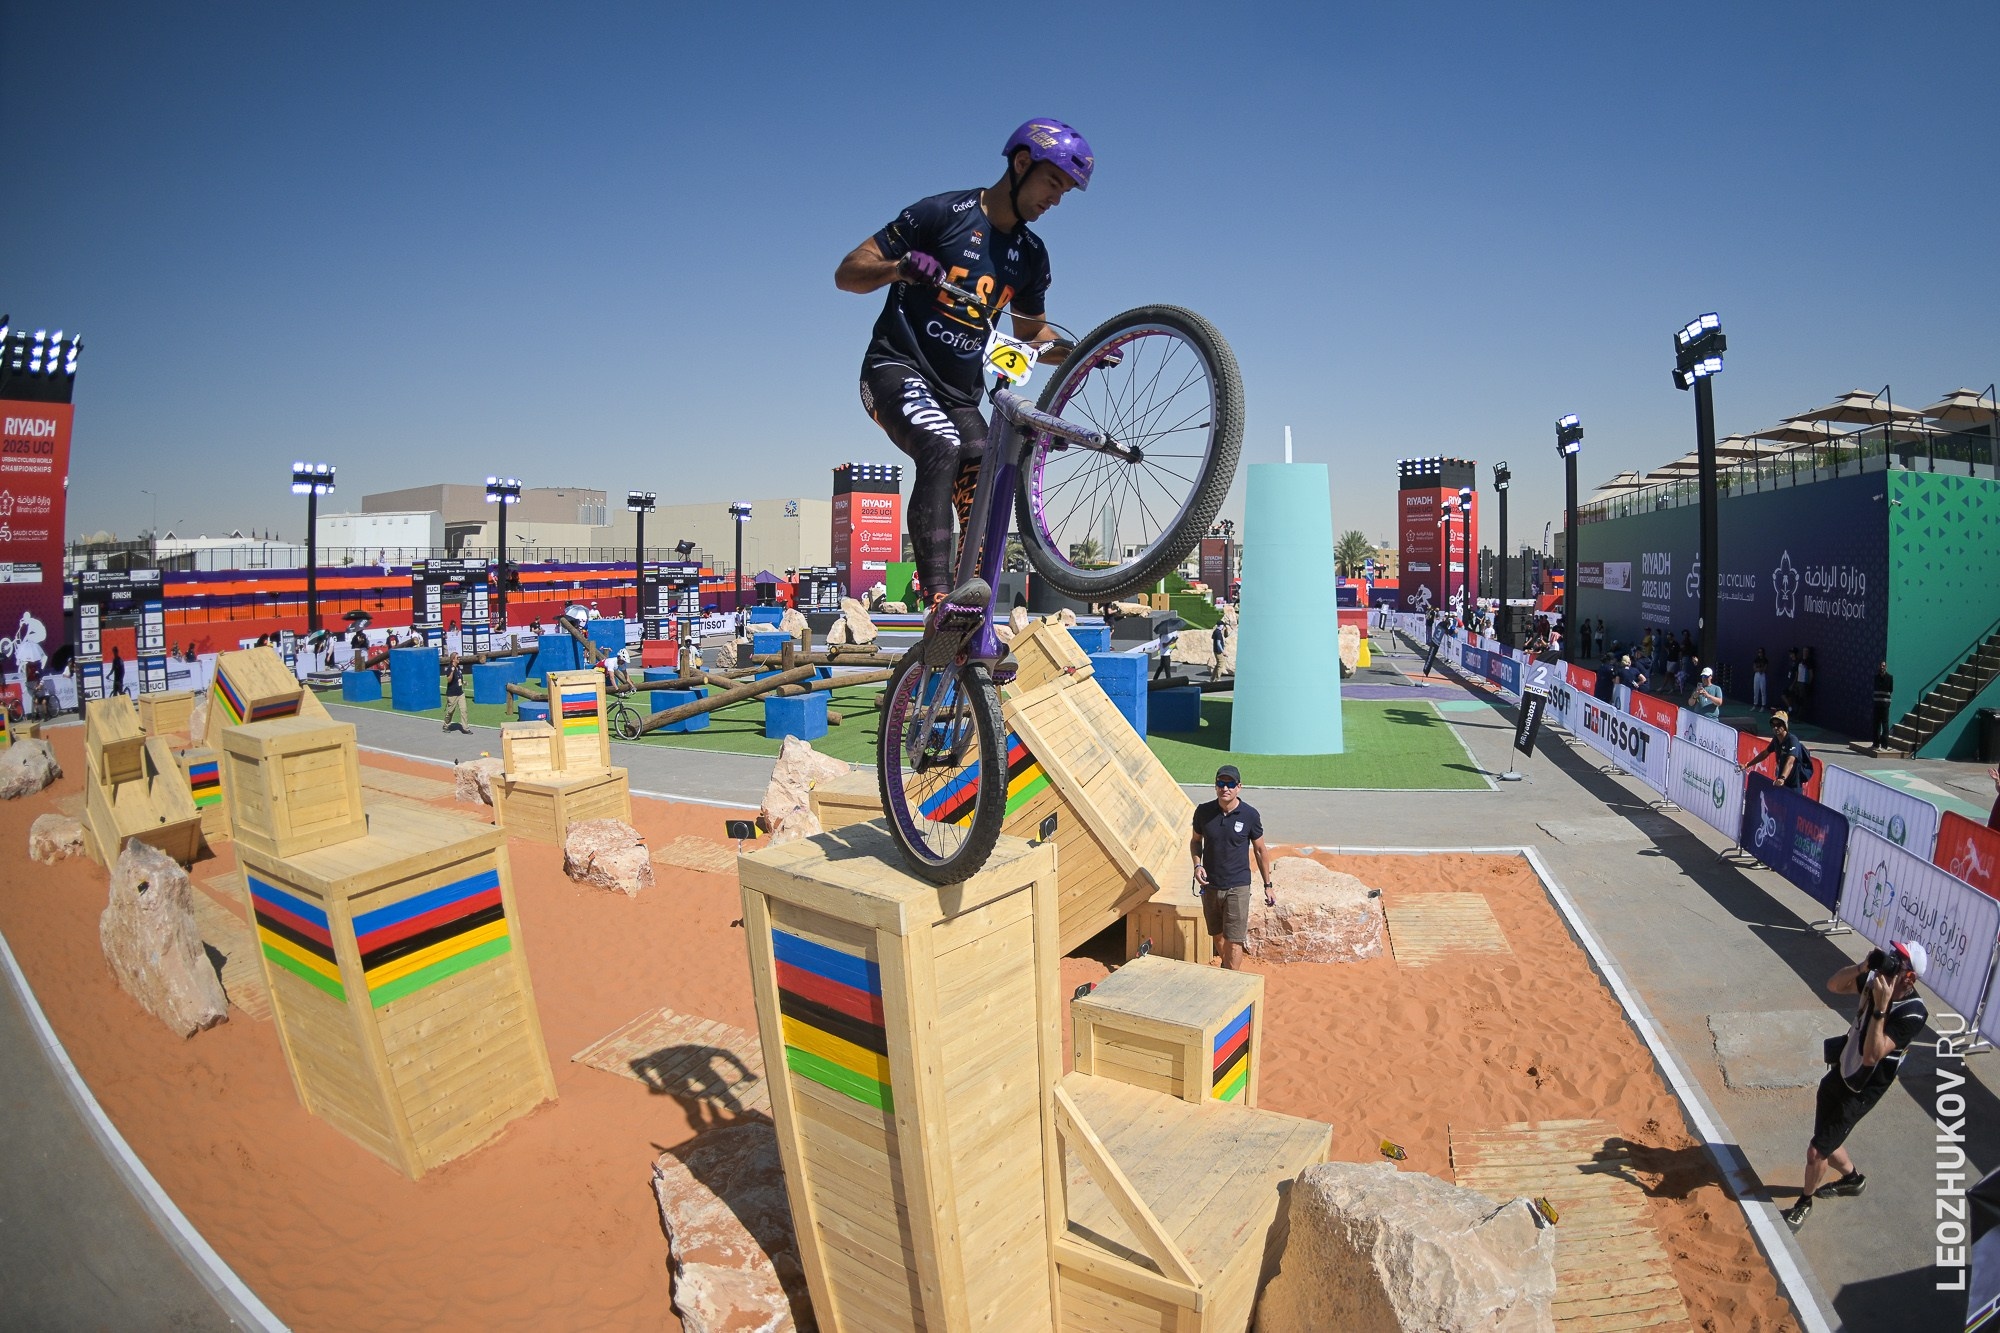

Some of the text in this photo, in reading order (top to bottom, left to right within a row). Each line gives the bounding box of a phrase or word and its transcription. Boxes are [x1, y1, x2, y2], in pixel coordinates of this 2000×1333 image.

[963, 249, 981, 261] GOBIK
[926, 320, 983, 351] Cofidis
[1005, 352, 1017, 369] 3
[4, 417, 56, 437] RIYADH
[2, 439, 54, 455] 2025 UCI
[0, 464, 52, 473] CHAMPIONSHIPS
[861, 498, 892, 508] RIYADH
[1406, 496, 1433, 505] RIYADH
[1641, 552, 1671, 575] RIYADH
[86, 573, 98, 582] UCI
[1726, 574, 1756, 589] CYCLING
[1804, 565, 1866, 596] وزارة الرياضة
[112, 590, 131, 599] FINISH
[1641, 580, 1671, 600] 2025 UCI
[84, 606, 97, 614] UCI
[1804, 594, 1865, 621] Ministry of Sport
[700, 619, 726, 631] TISSOT
[1435, 629, 1442, 638] 3
[286, 643, 292, 654] 2
[1533, 666, 1548, 684] 2
[1531, 686, 1543, 694] UCI
[1547, 684, 1571, 715] SSOT
[1520, 701, 1537, 746] #Riyadh2025
[1656, 711, 1671, 726] RIYADH
[1600, 711, 1650, 763] TISSOT
[1796, 816, 1826, 844] RIYADH
[1794, 833, 1810, 852] 2025
[1792, 855, 1820, 878] CHAMPIONSHIPS
[1900, 892, 1967, 956] وزارة الرياضة
[1926, 941, 1935, 958] of
[1935, 945, 1961, 977] Sport
